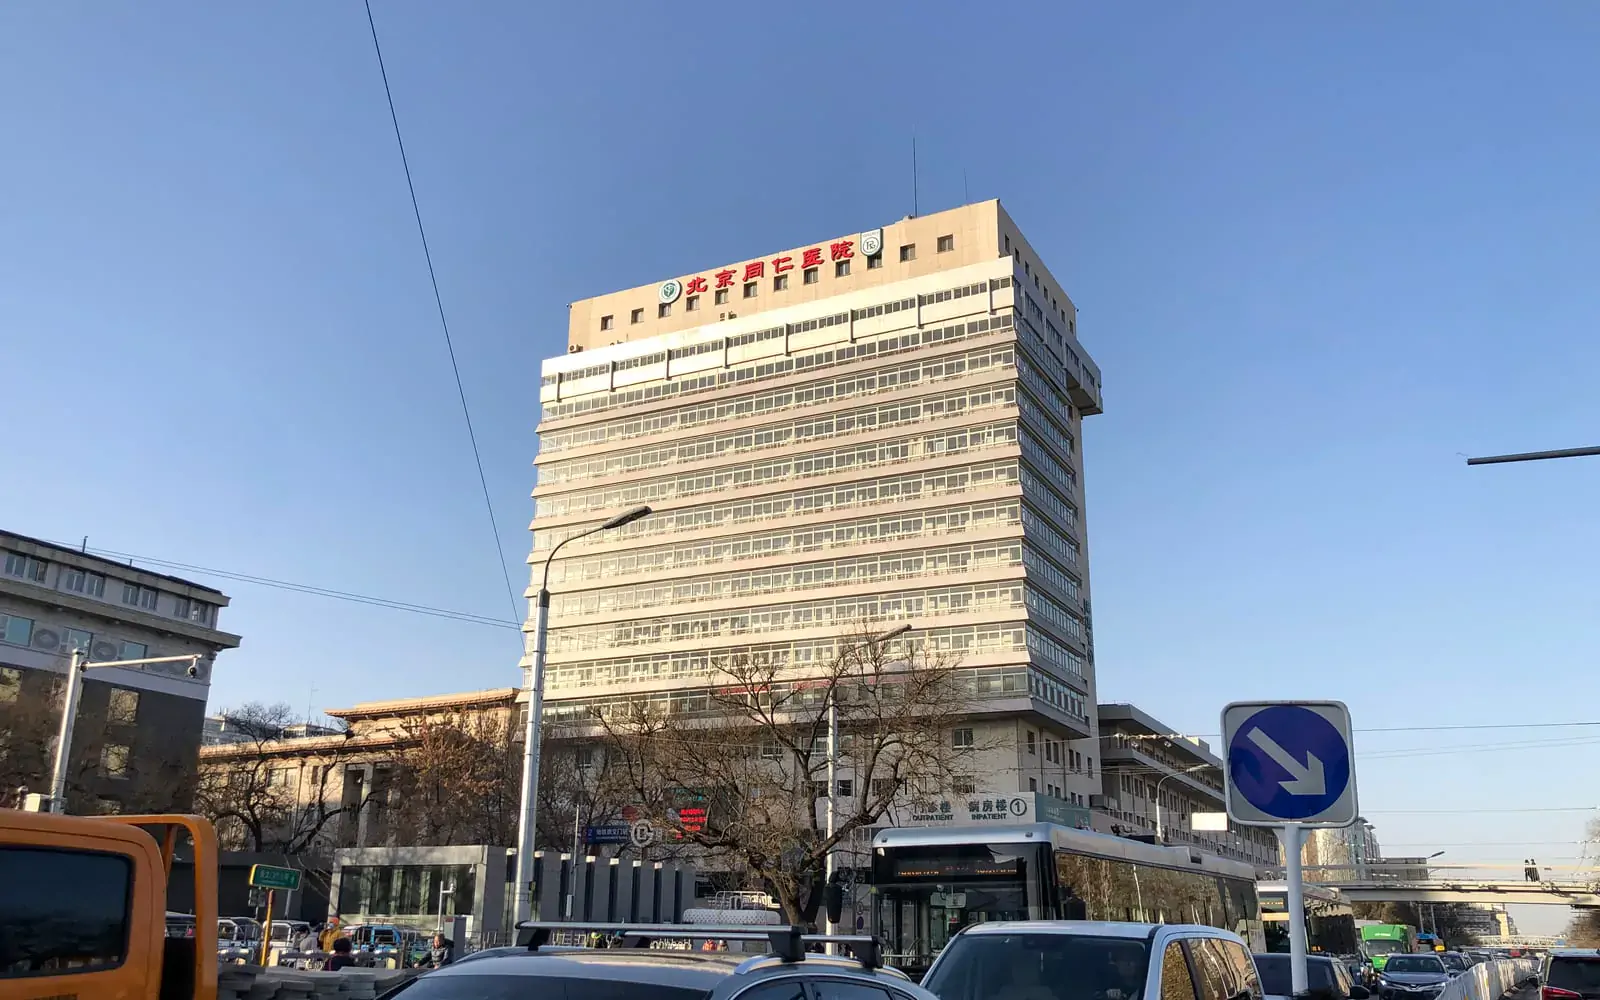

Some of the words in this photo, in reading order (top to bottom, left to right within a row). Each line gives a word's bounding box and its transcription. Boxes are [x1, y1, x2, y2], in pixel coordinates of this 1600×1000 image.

[686, 240, 855, 296] 北京同仁医院
[968, 799, 1007, 813] 病房楼
[971, 812, 1007, 820] INPATIENT
